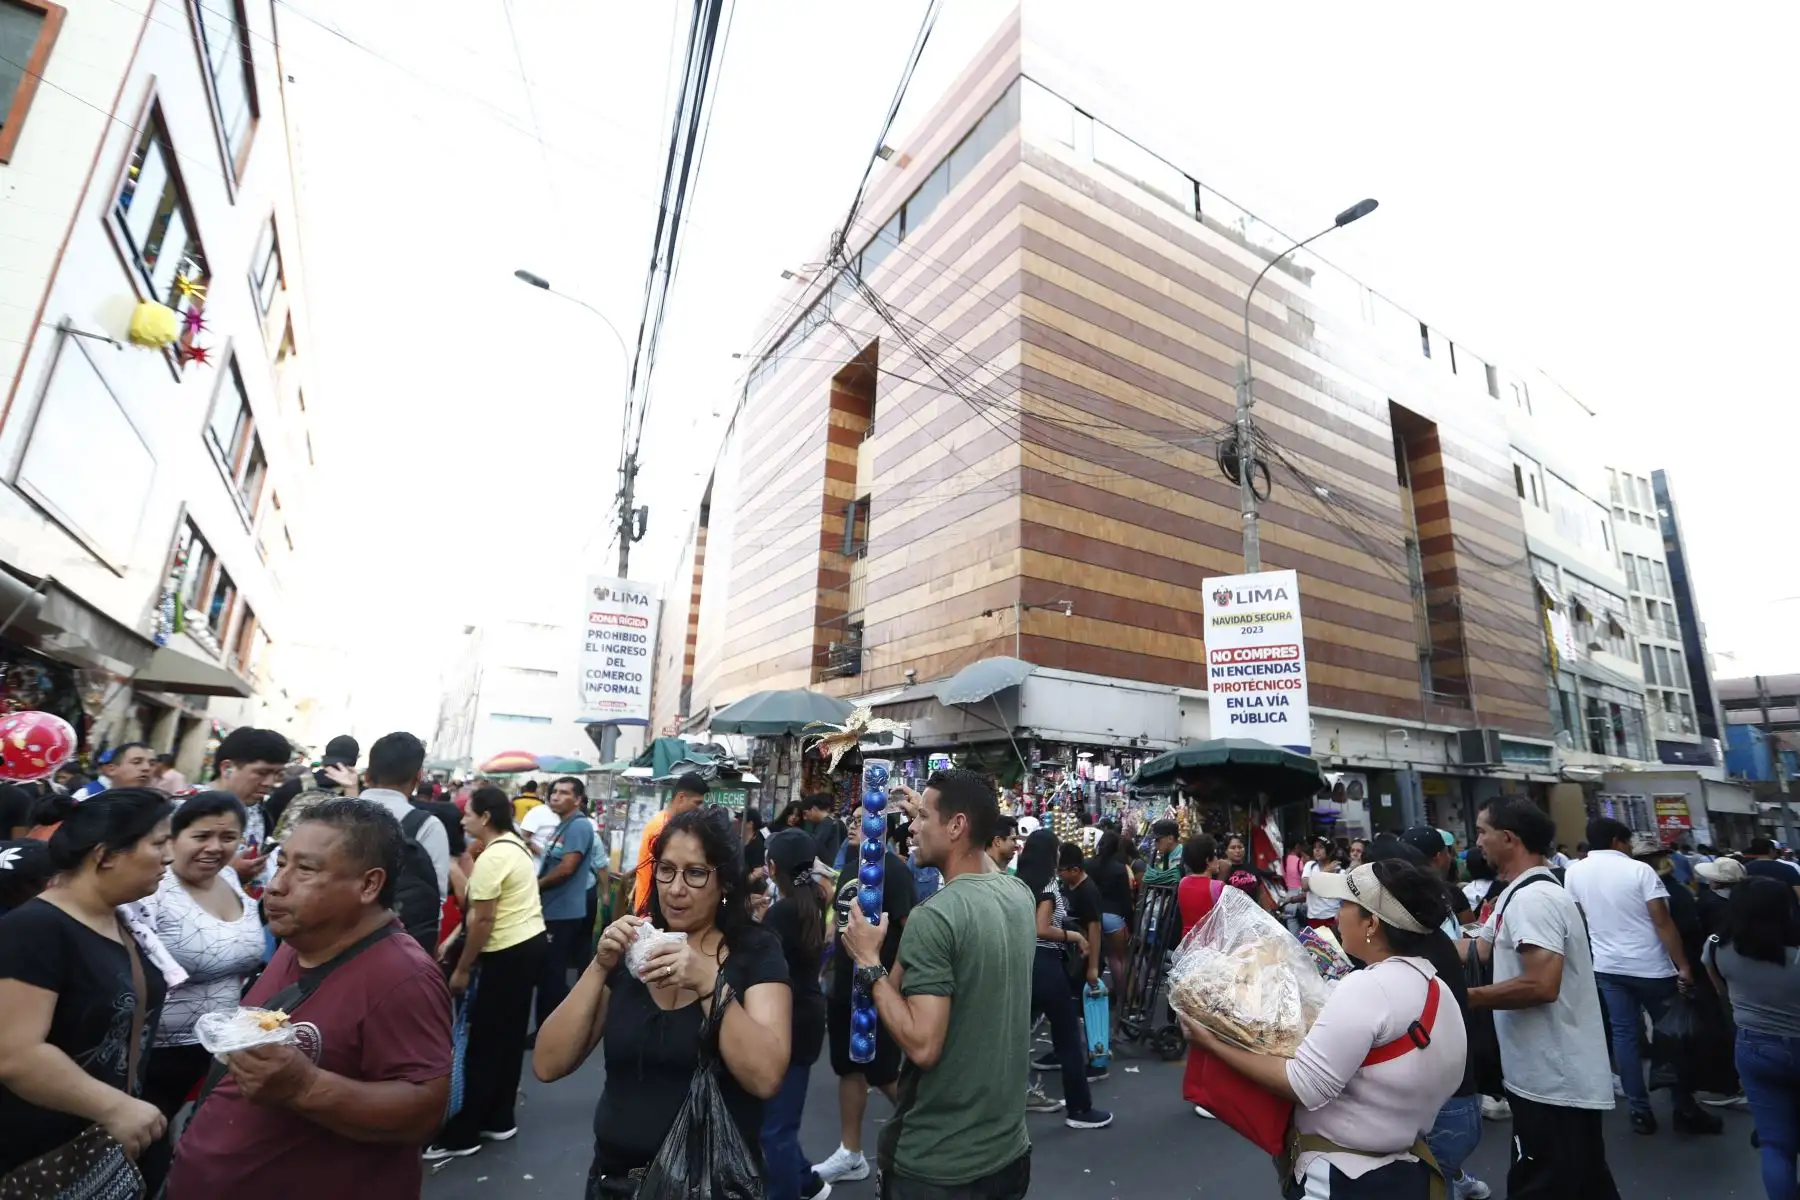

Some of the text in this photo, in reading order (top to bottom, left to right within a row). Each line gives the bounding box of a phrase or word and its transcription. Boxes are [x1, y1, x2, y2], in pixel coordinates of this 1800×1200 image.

[612, 591, 648, 606] LIMA
[1236, 588, 1288, 604] LIMA
[590, 613, 618, 625] ZONA
[1212, 612, 1292, 626] NAVIDAD SEGURA
[588, 629, 646, 643] PROHIBIDO
[1241, 626, 1263, 634] 2023
[585, 642, 646, 657] EL INGRESO
[1212, 646, 1298, 663] NO COMPRES
[606, 657, 626, 667] DEL
[586, 669, 642, 682] COMERCIO
[1211, 662, 1301, 678] NI ENCIENDAS
[586, 682, 641, 695] INFORMAL
[1213, 678, 1302, 693] PIROTÉCNICOS
[1227, 692, 1289, 708] EN LA VÍA
[1231, 710, 1287, 724] PÚBLICA
[718, 792, 745, 804] LECHE
